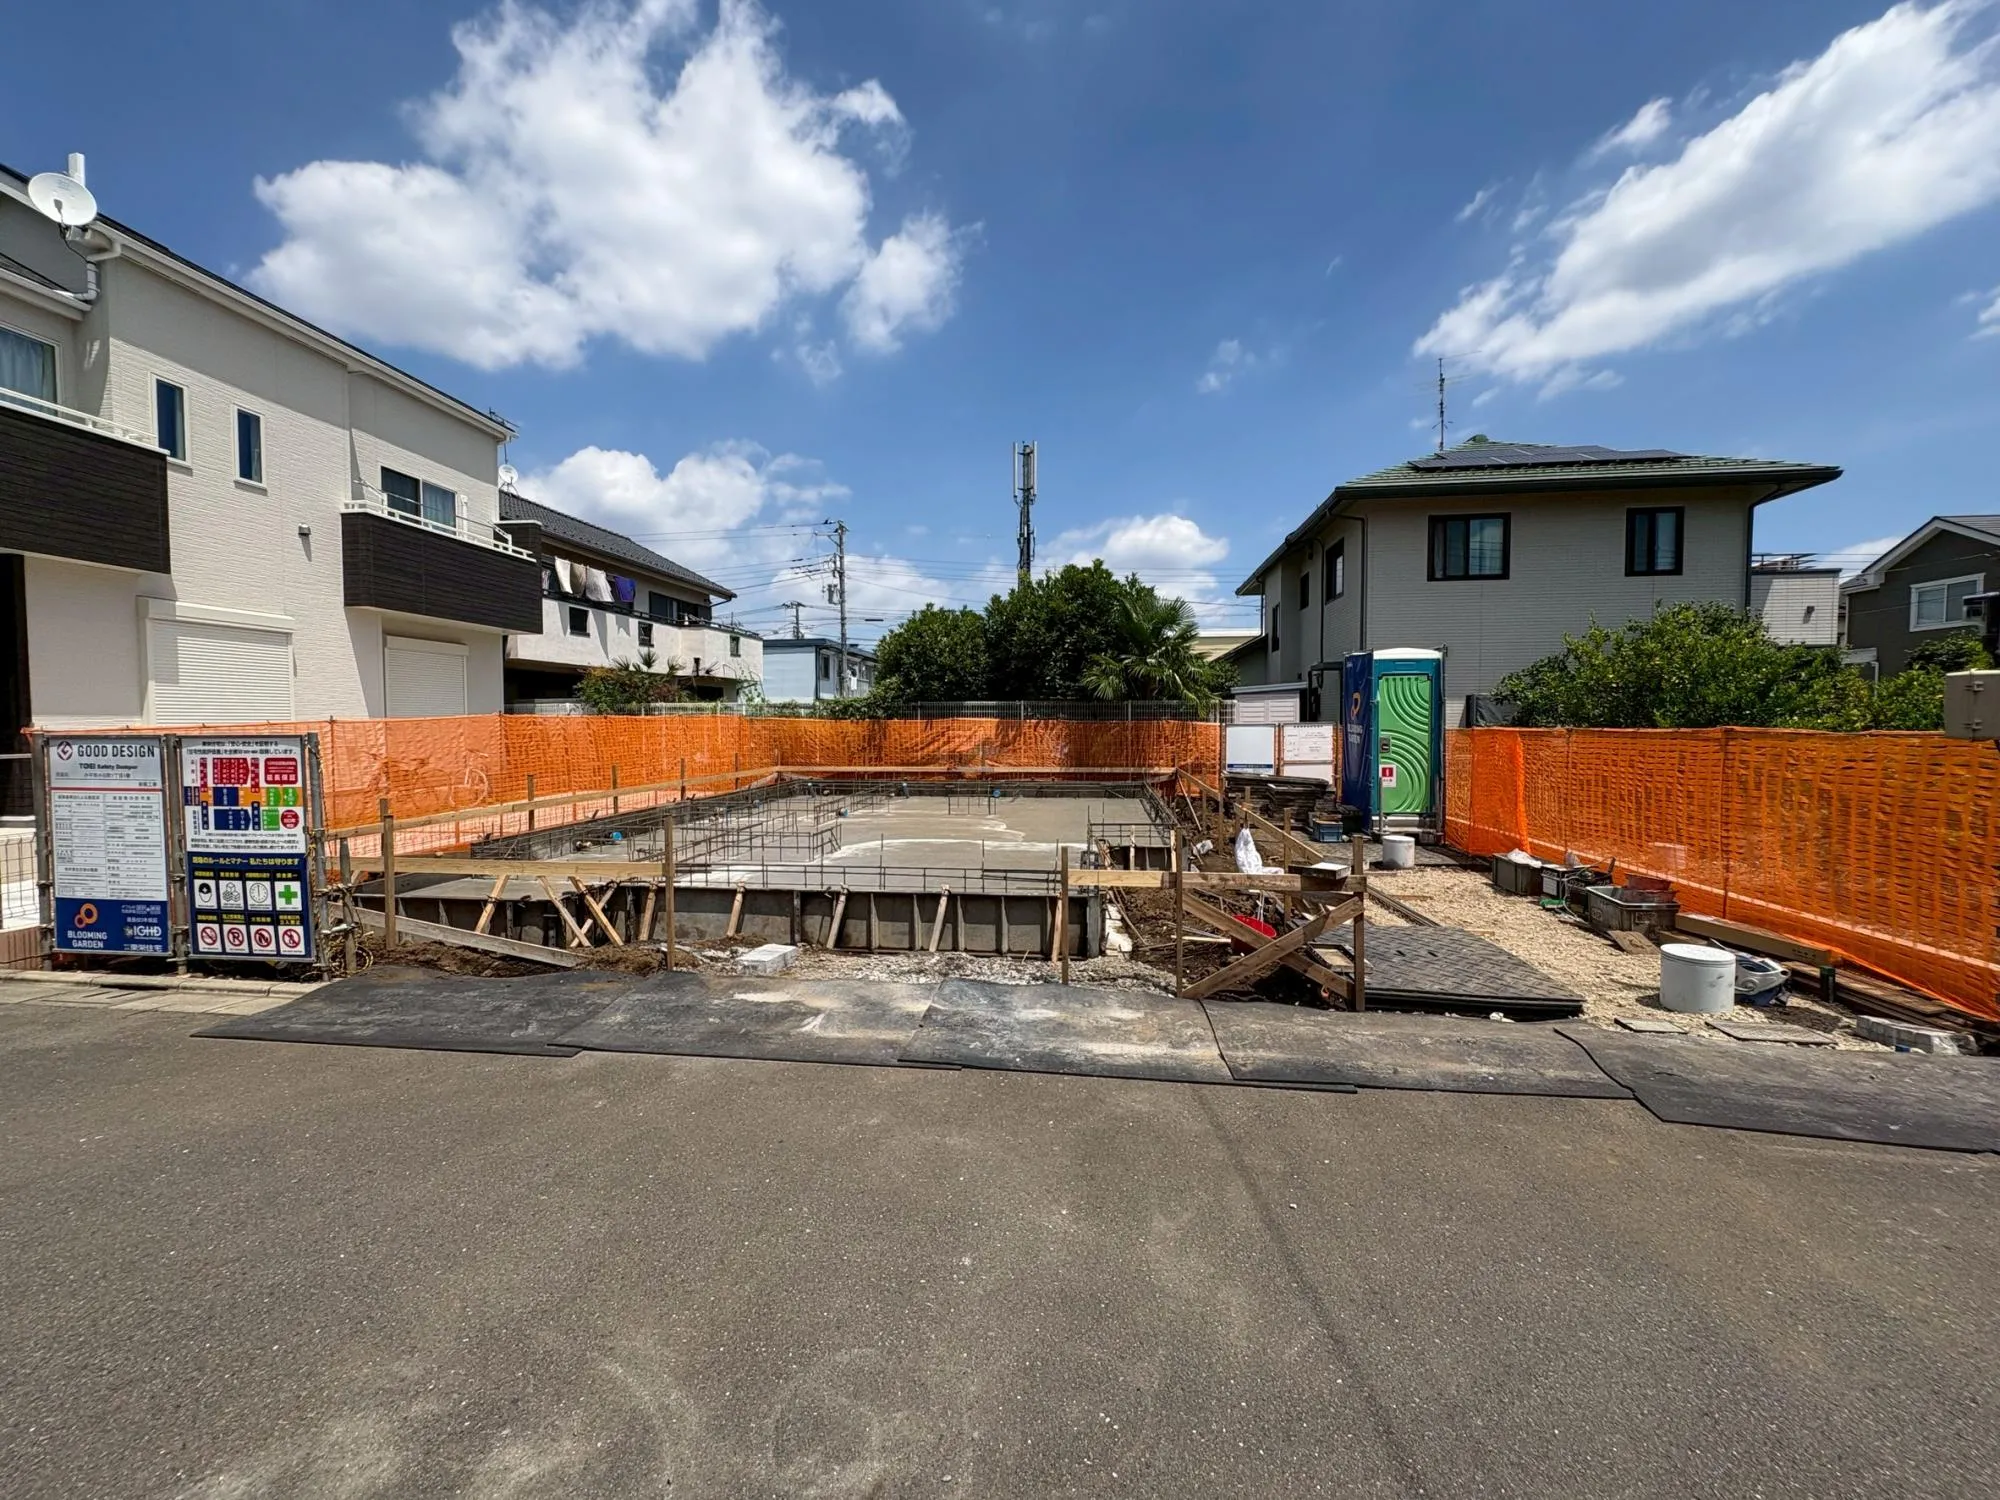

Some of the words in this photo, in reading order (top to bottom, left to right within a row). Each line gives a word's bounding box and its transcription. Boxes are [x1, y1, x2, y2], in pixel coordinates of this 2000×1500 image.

[77, 745, 108, 757] GOOD
[112, 745, 155, 757] DESIGN
[67, 930, 108, 940] BLOOMING
[72, 940, 104, 949] GARDEN
